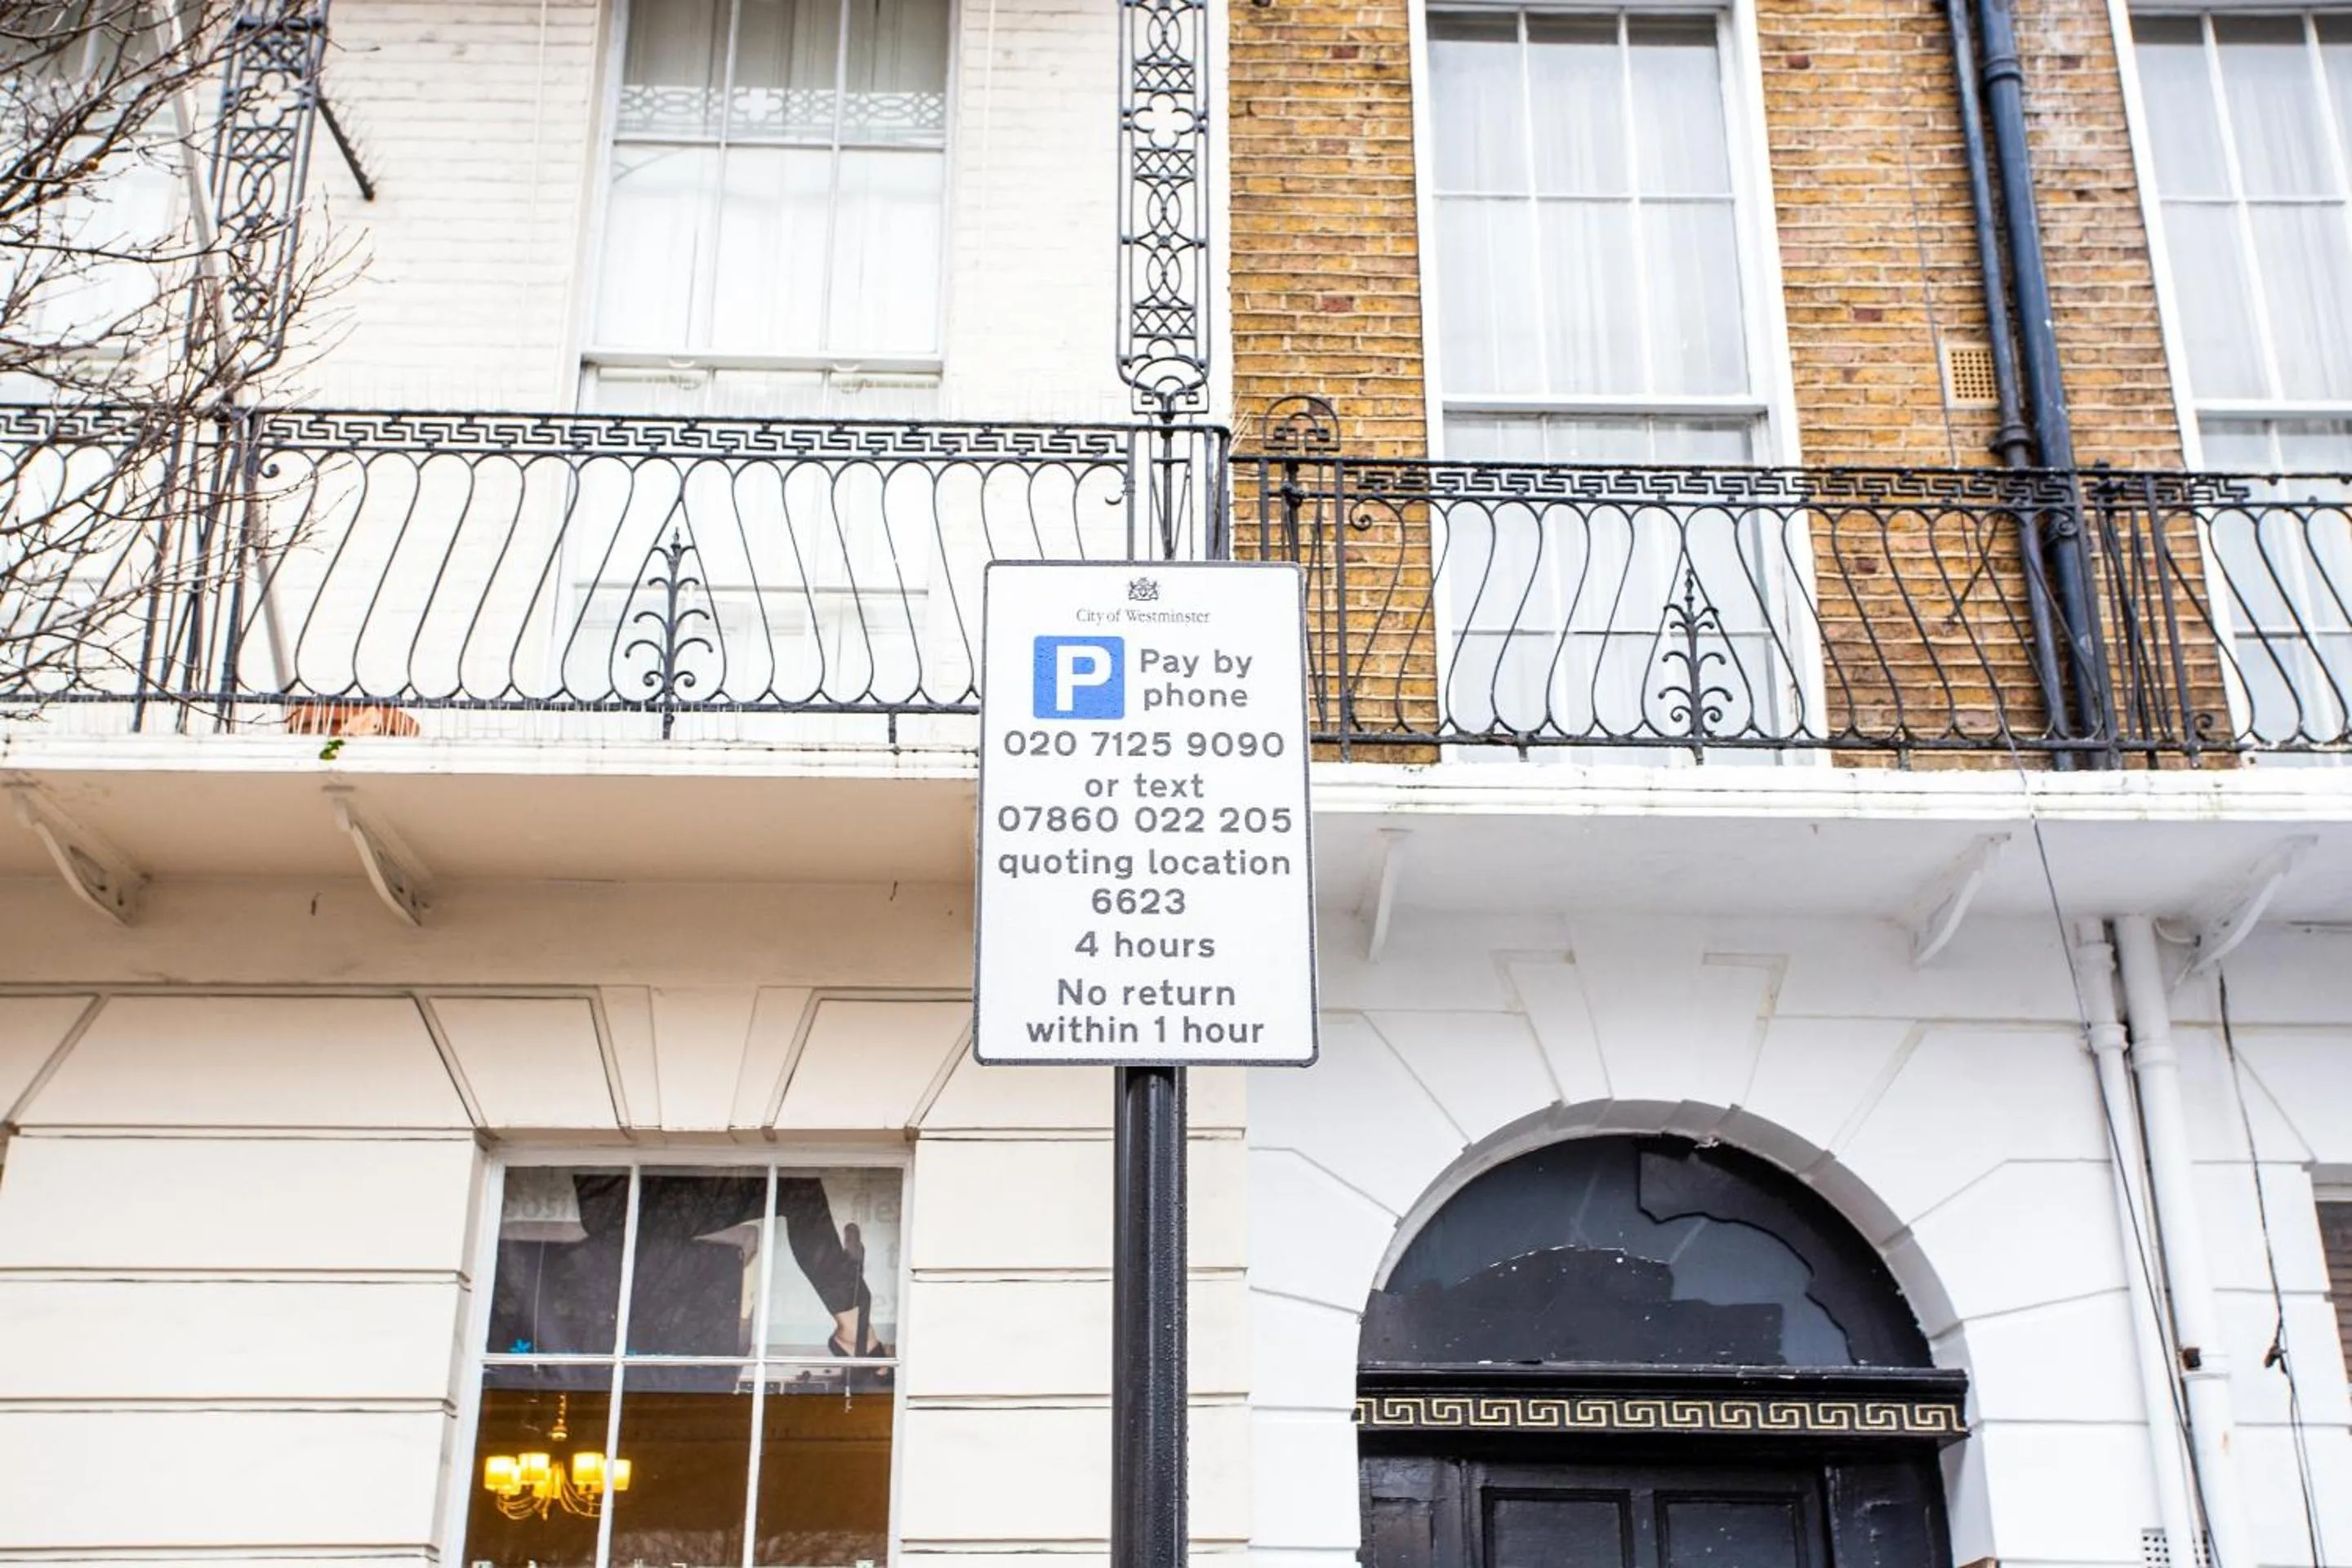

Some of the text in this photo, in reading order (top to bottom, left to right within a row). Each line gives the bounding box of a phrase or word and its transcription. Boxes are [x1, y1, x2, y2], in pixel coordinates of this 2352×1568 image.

[1076, 608, 1210, 626] City of Westminster
[1140, 648, 1253, 679] Pay by
[1055, 644, 1113, 713] P
[1143, 681, 1248, 711] phone
[1004, 729, 1285, 759] 020 7125 9090
[1085, 772, 1205, 799] or text
[998, 805, 1292, 834] 07860 022 205
[998, 848, 1290, 880] quoting location
[1091, 888, 1187, 915] 6623
[1074, 930, 1215, 959] 4 hours
[1058, 978, 1236, 1006] No return
[1026, 1015, 1265, 1044] within 1 hour
